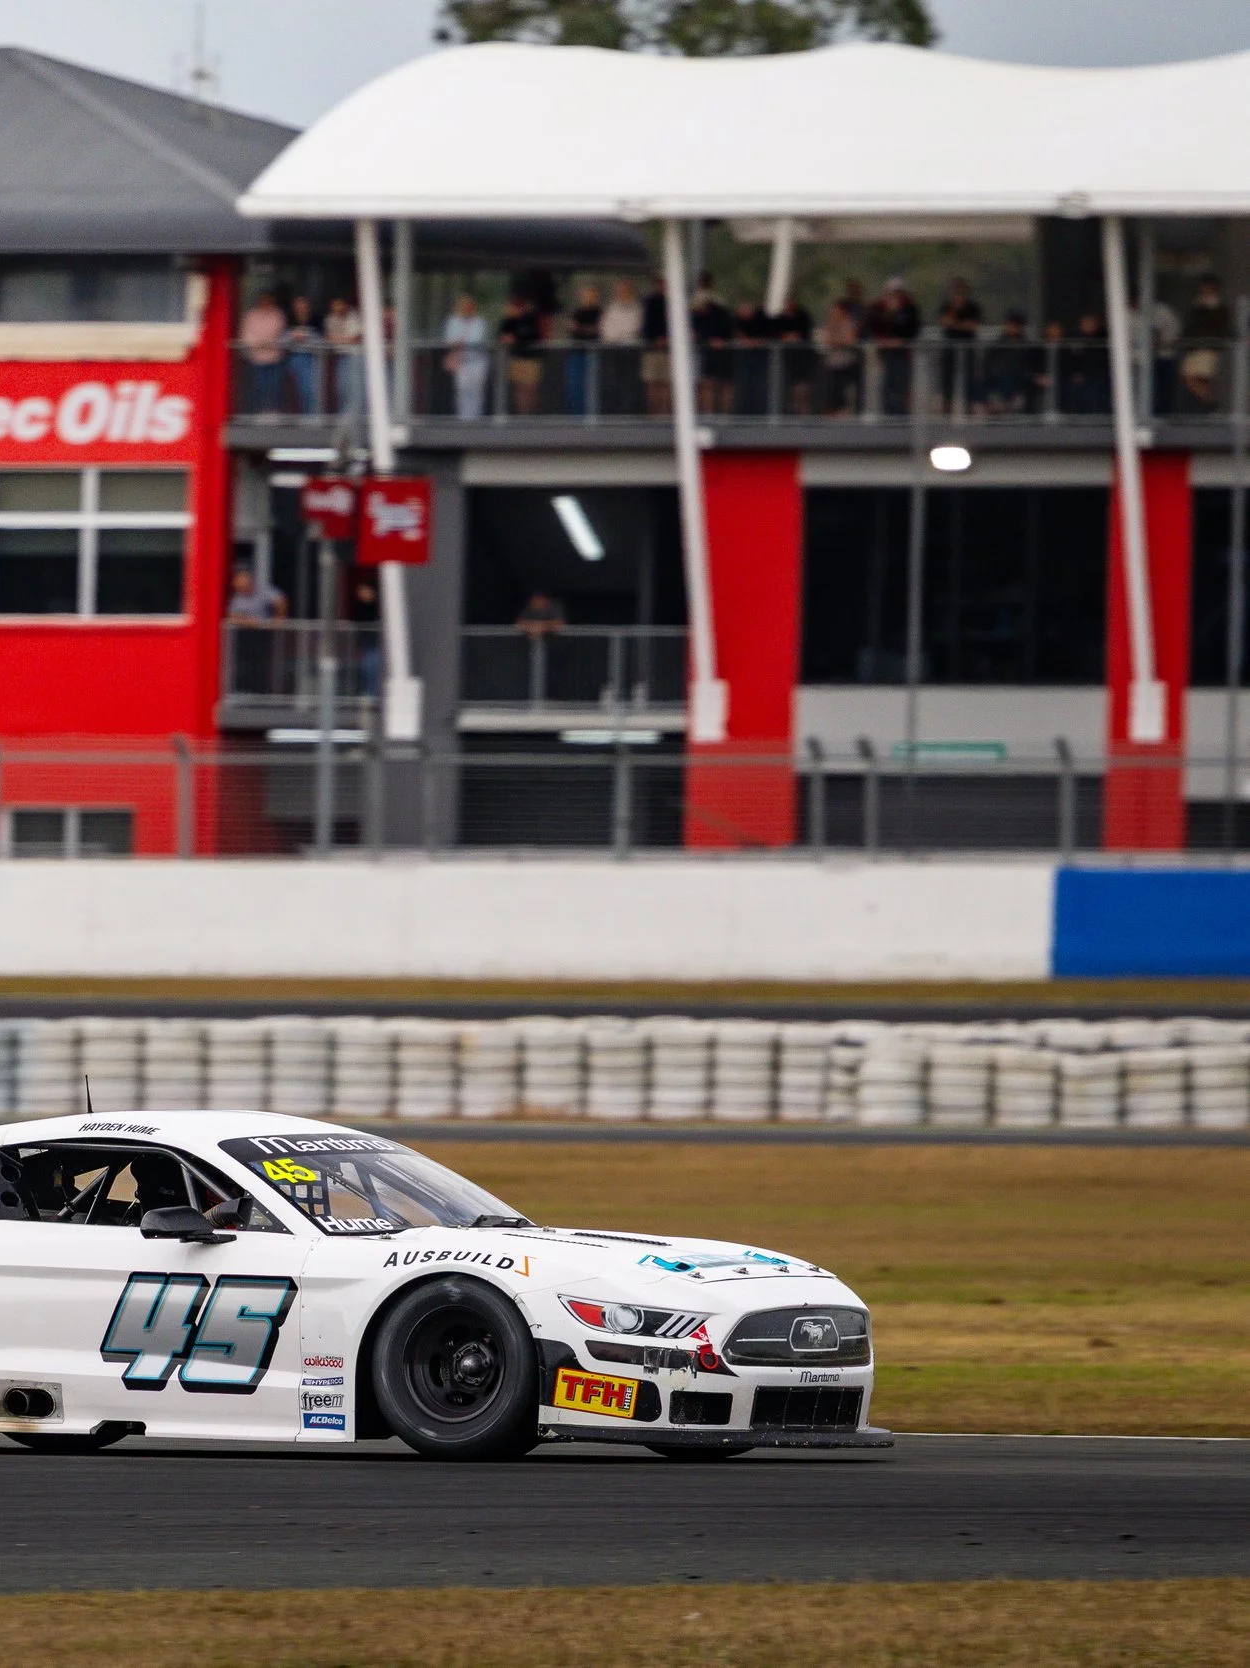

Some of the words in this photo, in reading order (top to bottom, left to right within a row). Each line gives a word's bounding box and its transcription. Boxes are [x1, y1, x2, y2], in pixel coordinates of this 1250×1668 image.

[54, 380, 191, 444] Oils
[78, 1122, 126, 1132] HAYDEN
[123, 1124, 161, 1136] HUME
[261, 1158, 317, 1184] 45
[314, 1215, 393, 1233] Hume
[383, 1250, 515, 1270] AUSBUILD
[99, 1271, 299, 1395] 45
[561, 1374, 628, 1409] TFH
[623, 1386, 633, 1409] HIRE
